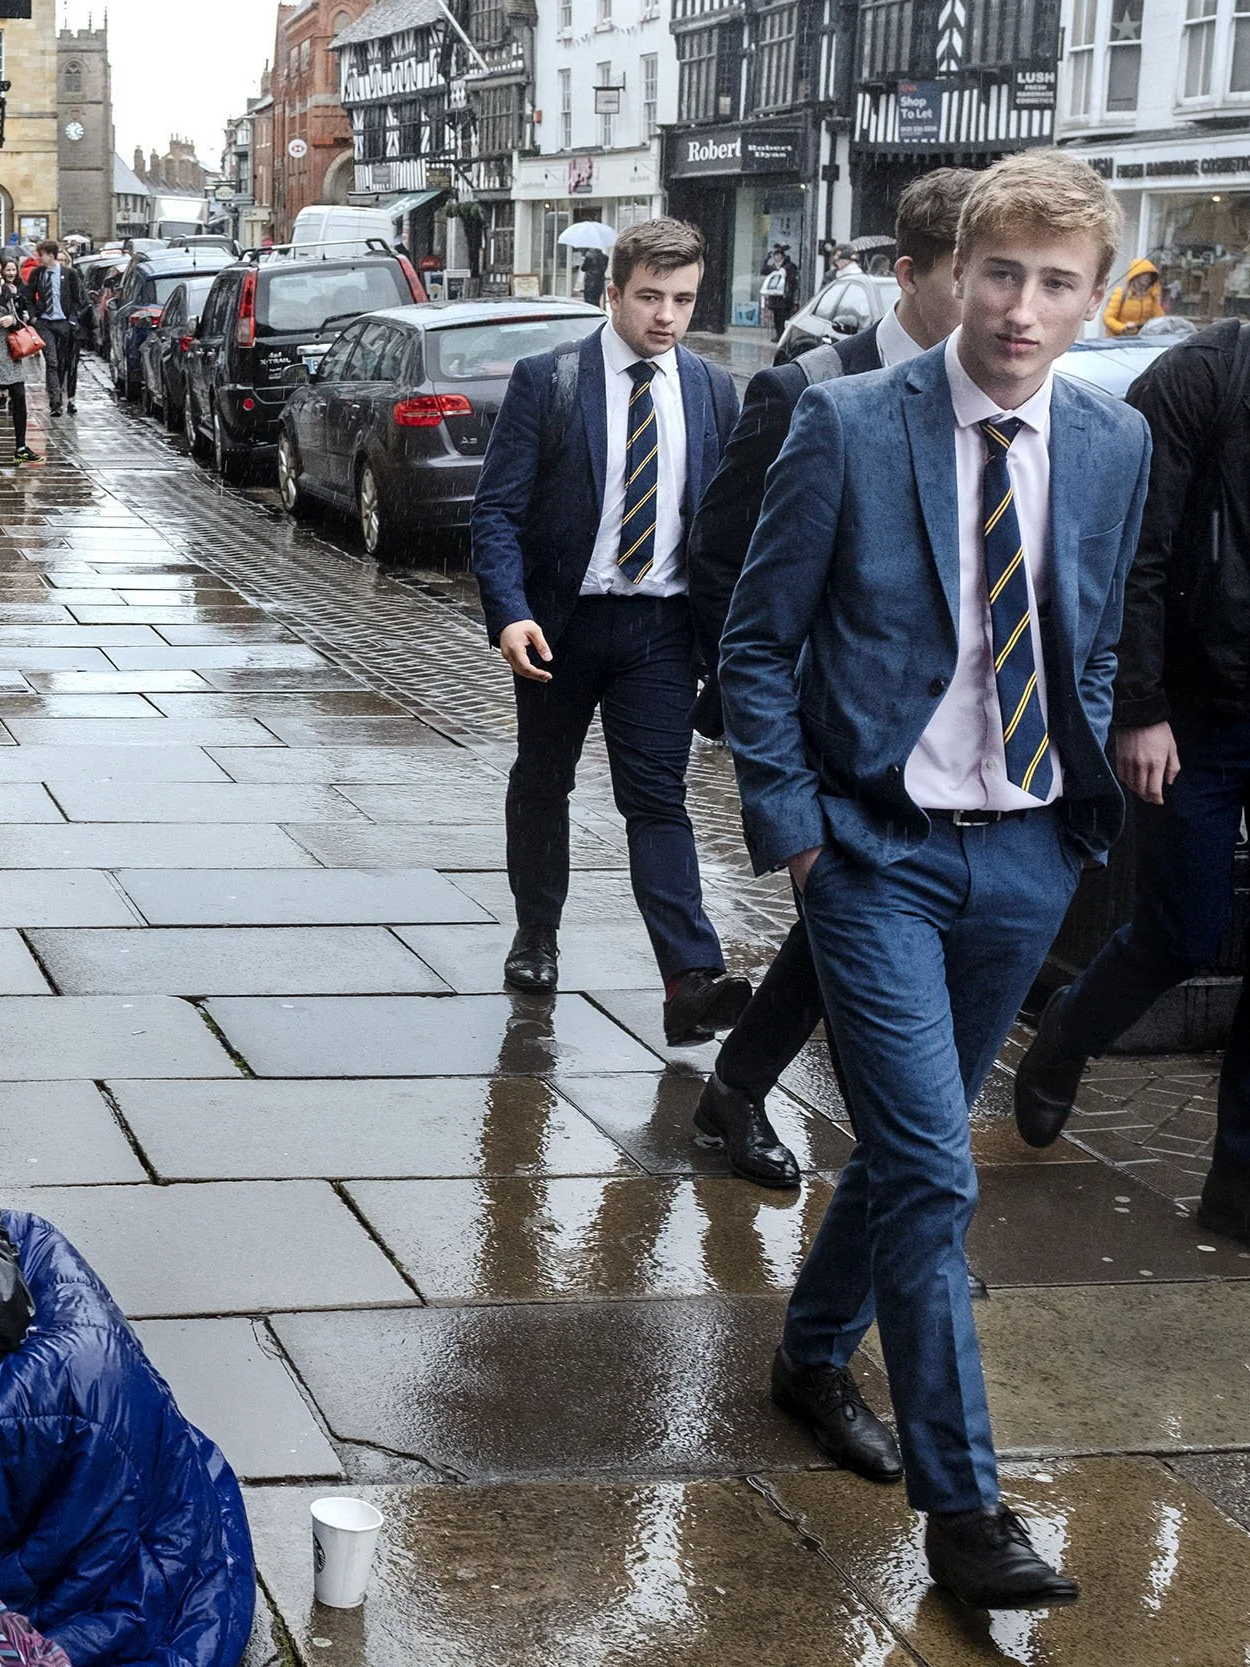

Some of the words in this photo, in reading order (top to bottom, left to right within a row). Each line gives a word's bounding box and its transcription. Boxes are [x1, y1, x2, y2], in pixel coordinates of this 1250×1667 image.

[1017, 72, 1055, 84] LUSH
[900, 96, 927, 108] Shop
[900, 108, 915, 119] To
[916, 108, 933, 119] Let
[687, 137, 742, 162] Robert
[747, 144, 793, 152] Robert
[754, 151, 787, 159] Dyas
